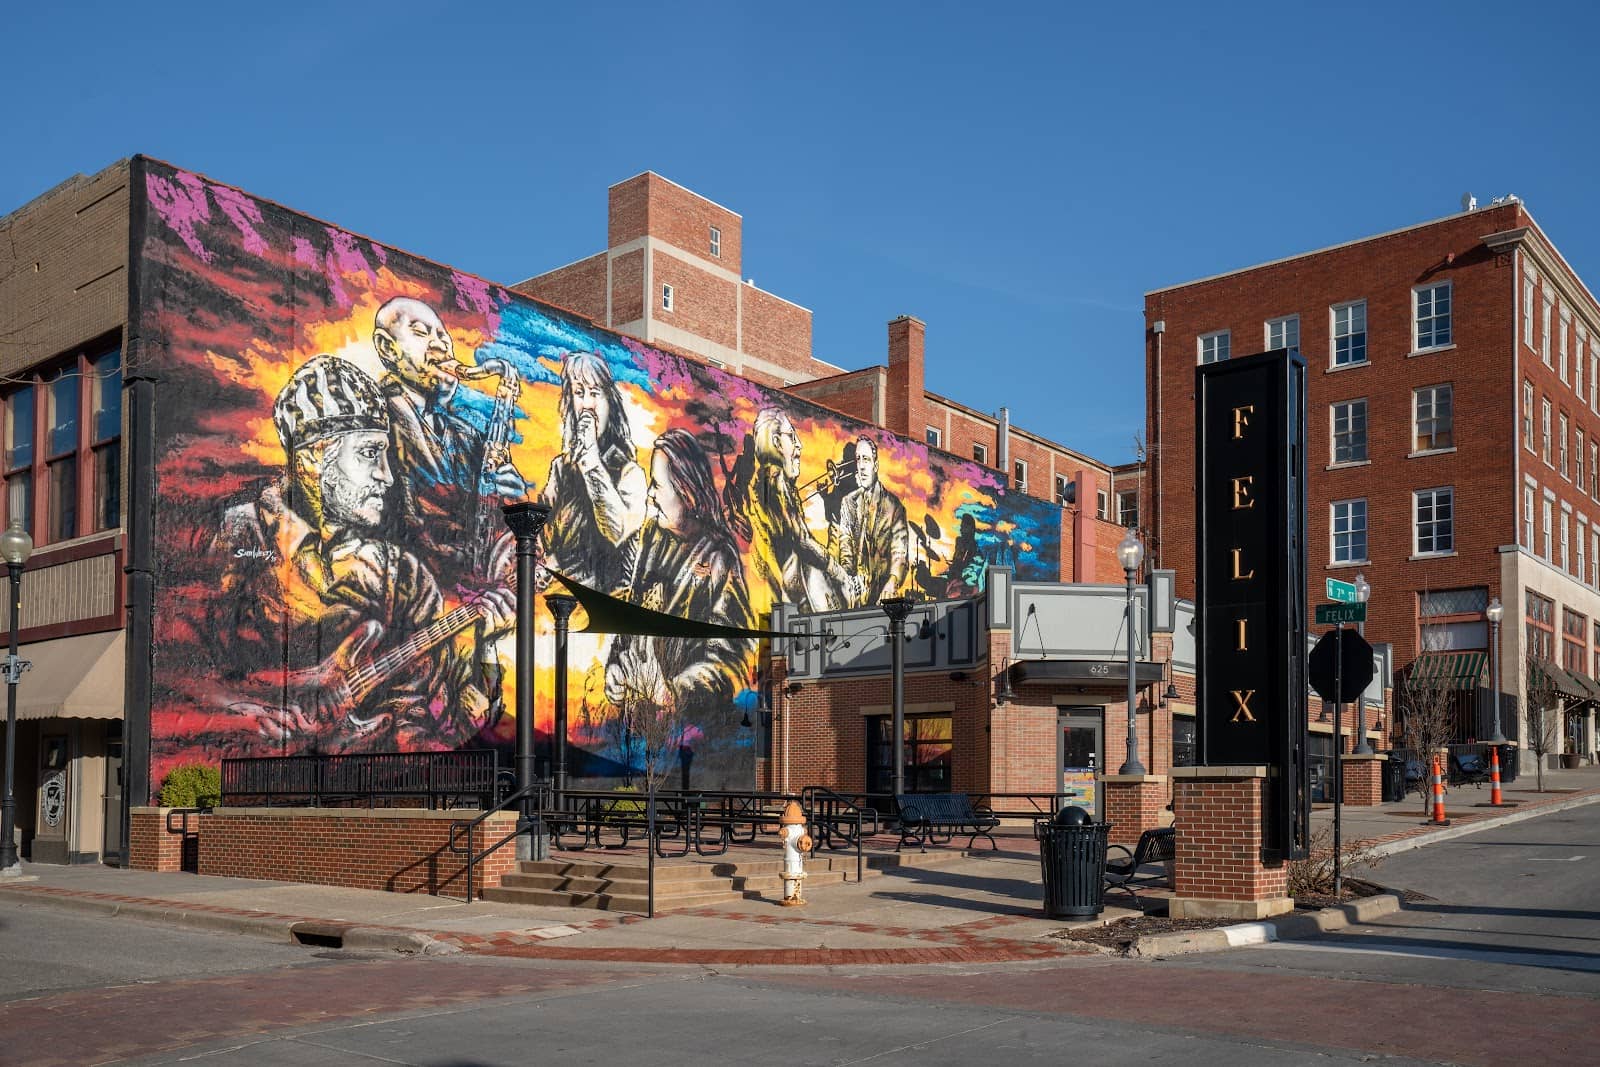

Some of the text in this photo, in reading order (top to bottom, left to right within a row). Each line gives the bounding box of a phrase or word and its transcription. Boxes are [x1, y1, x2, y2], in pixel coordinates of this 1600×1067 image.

[1230, 404, 1257, 722] FELIX
[1326, 609, 1354, 621] FELIX
[1090, 664, 1109, 674] 625
